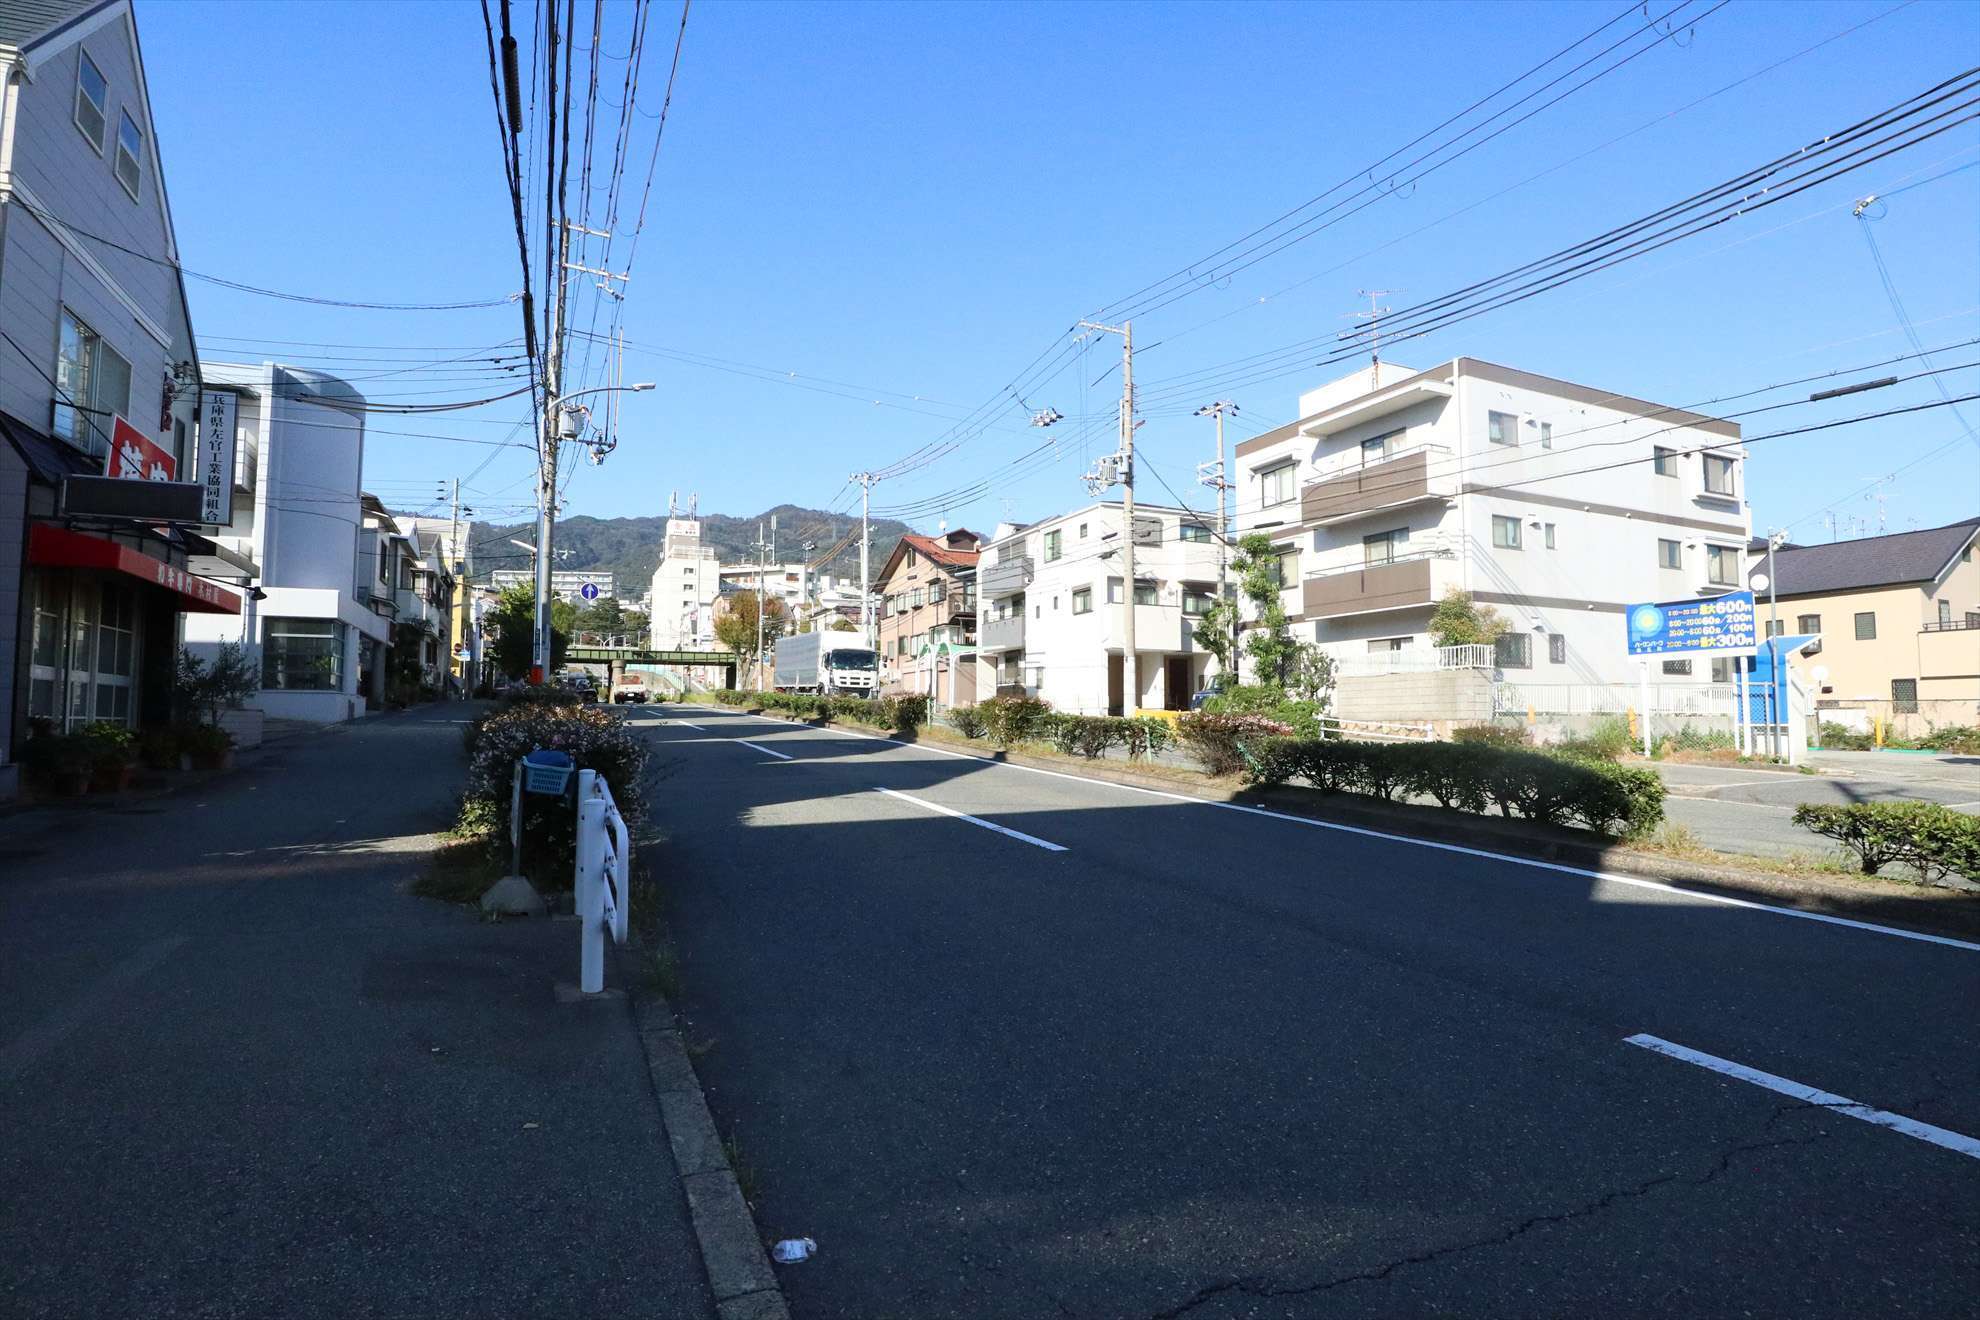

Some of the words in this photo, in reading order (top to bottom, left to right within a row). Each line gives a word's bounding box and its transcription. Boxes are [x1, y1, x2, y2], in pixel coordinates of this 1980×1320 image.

[206, 394, 225, 522] 兵庫県左官工業協同組合
